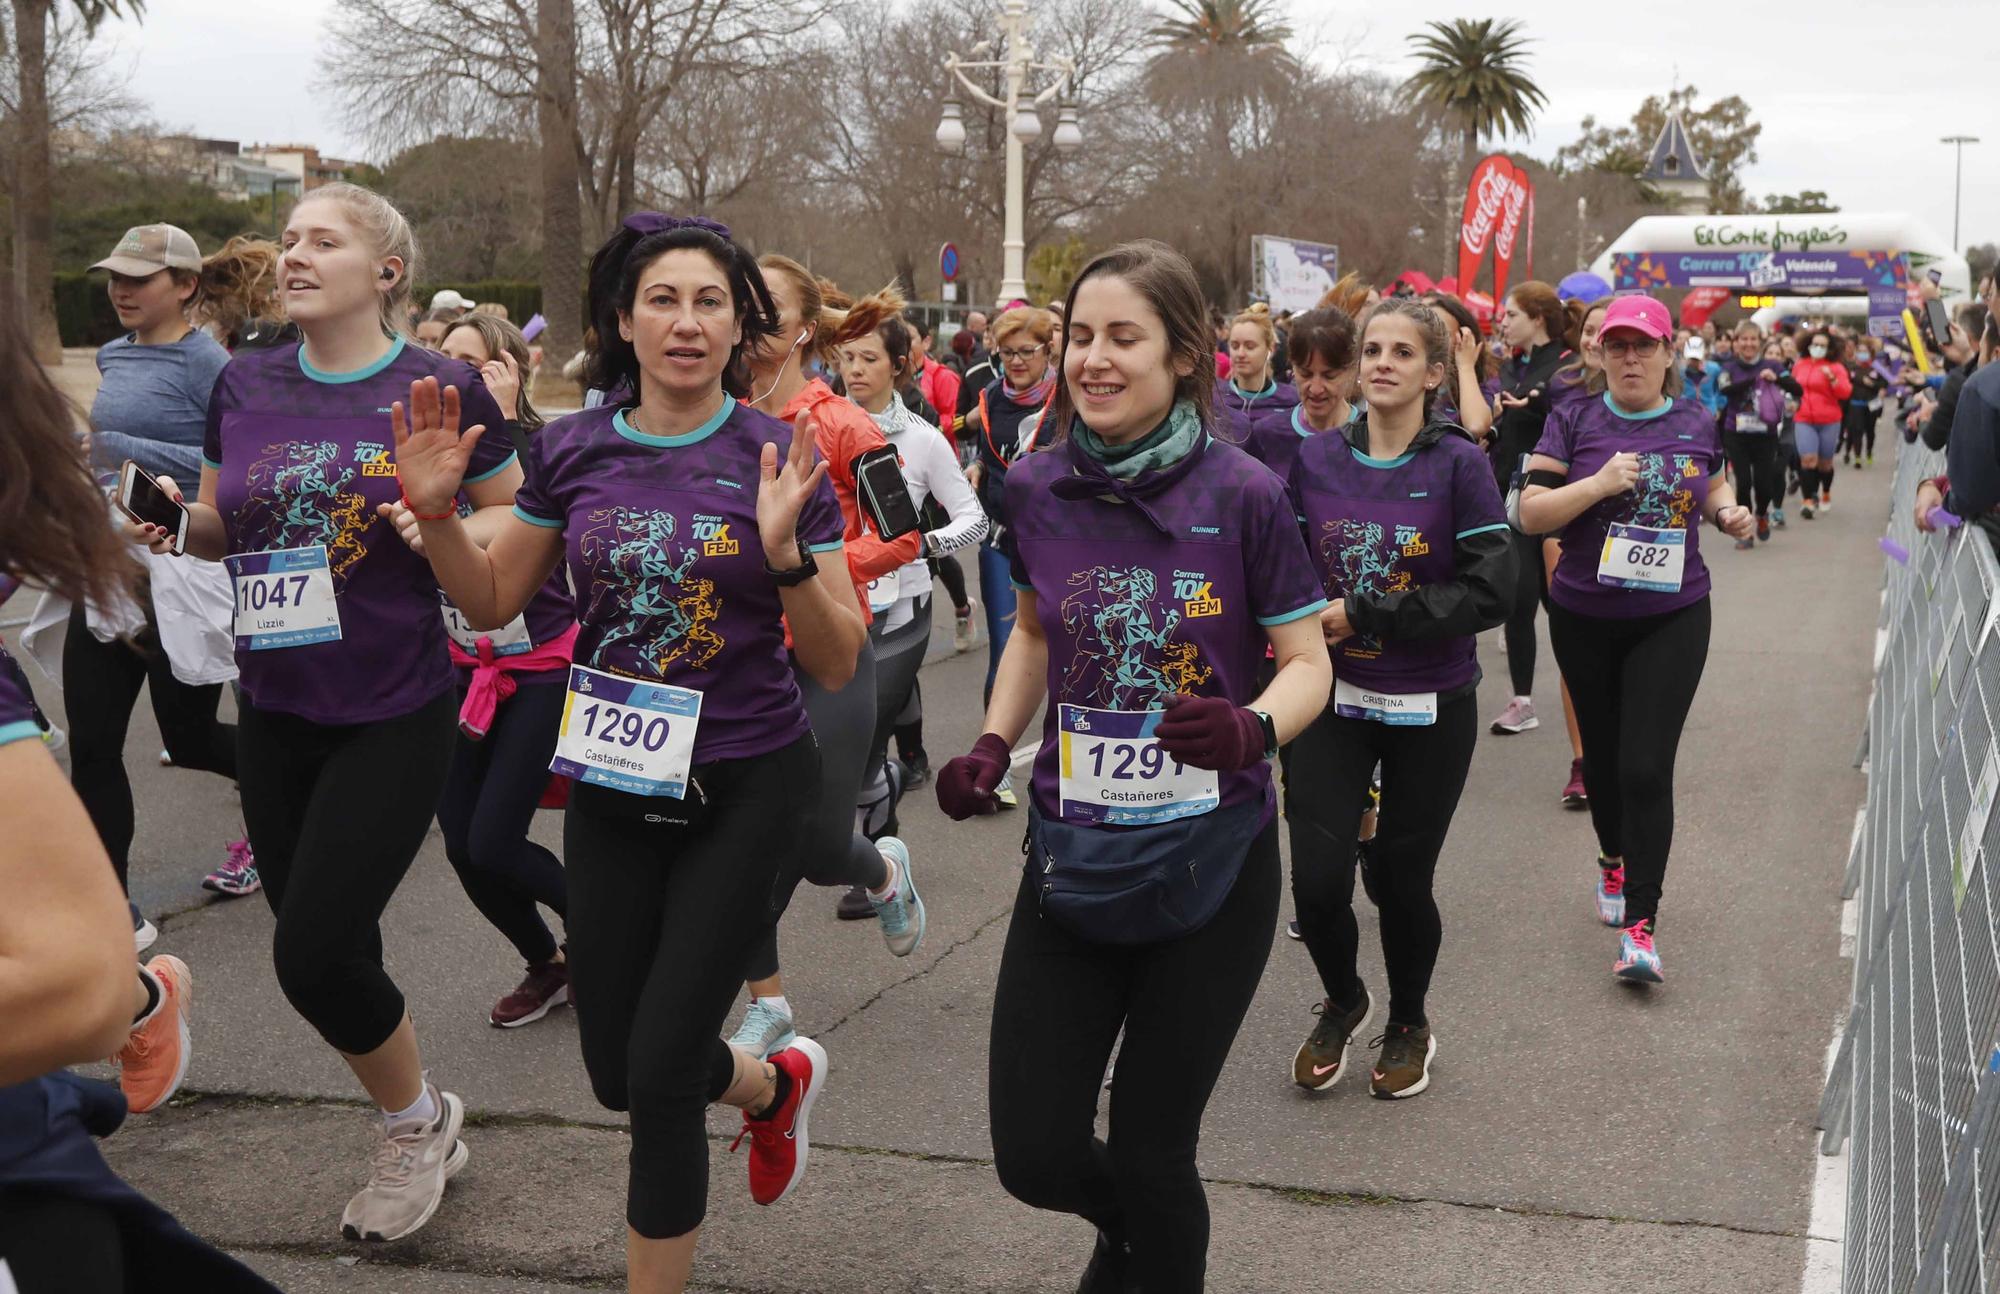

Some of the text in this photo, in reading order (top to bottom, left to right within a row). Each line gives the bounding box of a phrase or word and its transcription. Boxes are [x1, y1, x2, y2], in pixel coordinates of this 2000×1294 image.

[1694, 225, 1715, 245] El
[1717, 226, 1768, 245] Corte
[1679, 256, 1735, 272] Carrera
[1785, 259, 1838, 273] Valencia
[356, 441, 385, 449] Carrera
[364, 465, 395, 475] FEM
[716, 479, 743, 489] RUNNEK
[692, 513, 723, 522] Carrera
[691, 522, 730, 541] 10K
[1191, 526, 1220, 534] RUNNEK
[707, 541, 736, 555] FEM
[1405, 546, 1427, 556] FEM
[1627, 545, 1670, 567] 682
[1173, 569, 1205, 579] Carrera
[242, 575, 310, 612] 1047
[1172, 579, 1213, 601] 10K
[1189, 601, 1219, 616] FEM
[257, 618, 285, 629] Lizzie
[1362, 695, 1404, 707] CRISTINA
[583, 703, 670, 751] 1290
[585, 748, 644, 772] Castañeres
[1101, 788, 1174, 802] Castañeres
